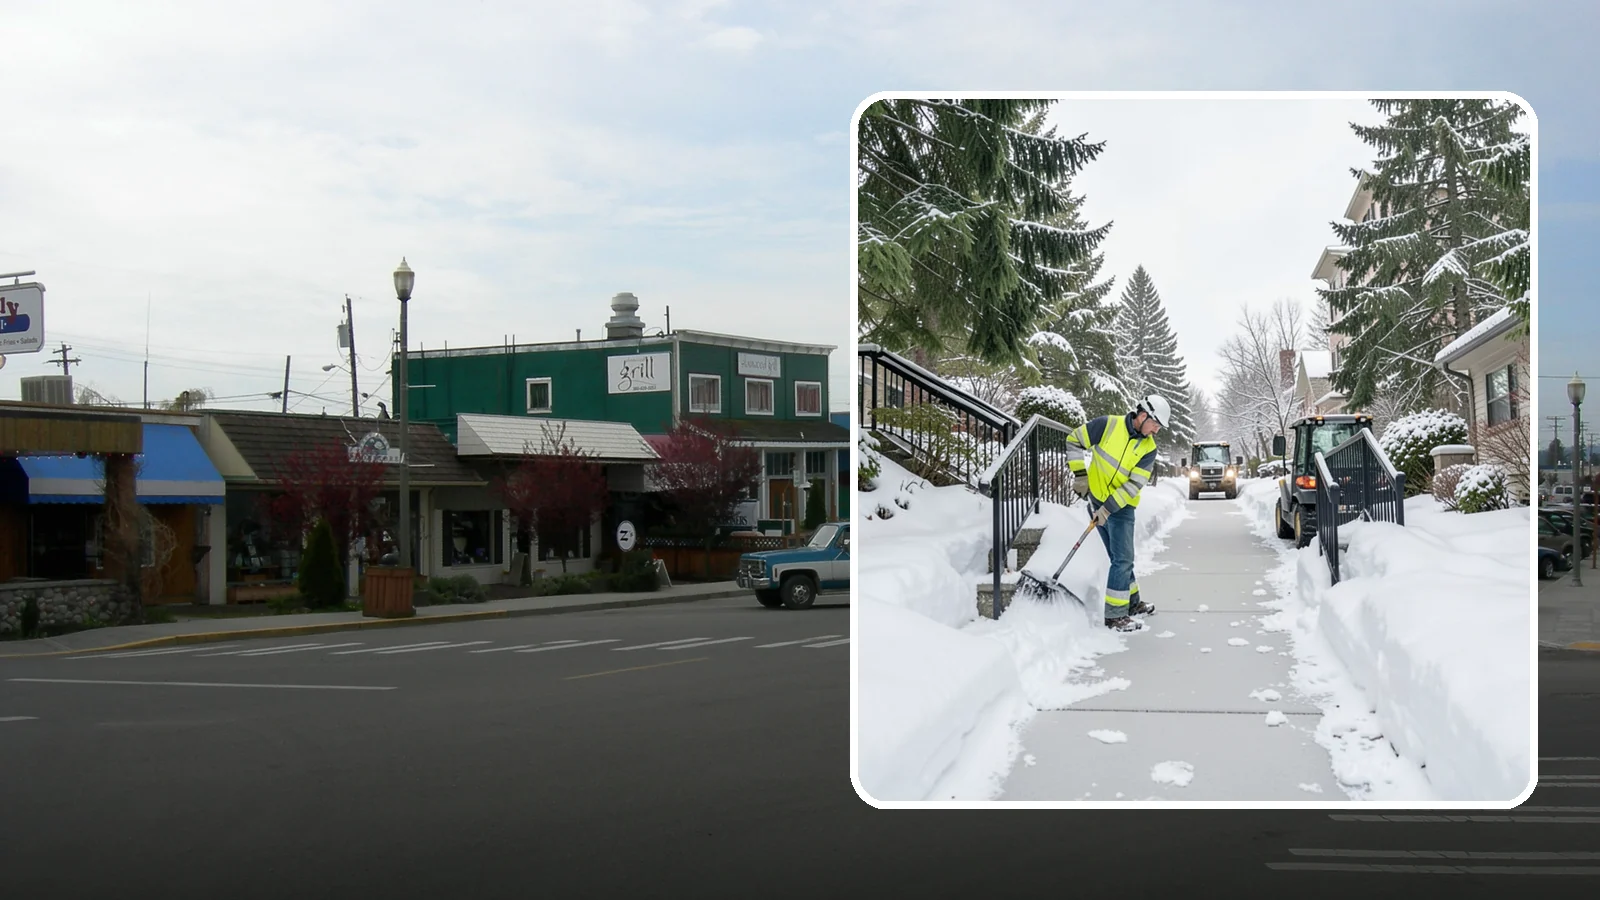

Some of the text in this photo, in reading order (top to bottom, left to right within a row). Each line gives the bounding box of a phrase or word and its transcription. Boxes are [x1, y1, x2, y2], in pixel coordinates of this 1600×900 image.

[3, 338, 17, 346] Fries
[20, 336, 38, 345] Salads
[617, 356, 655, 391] grill
